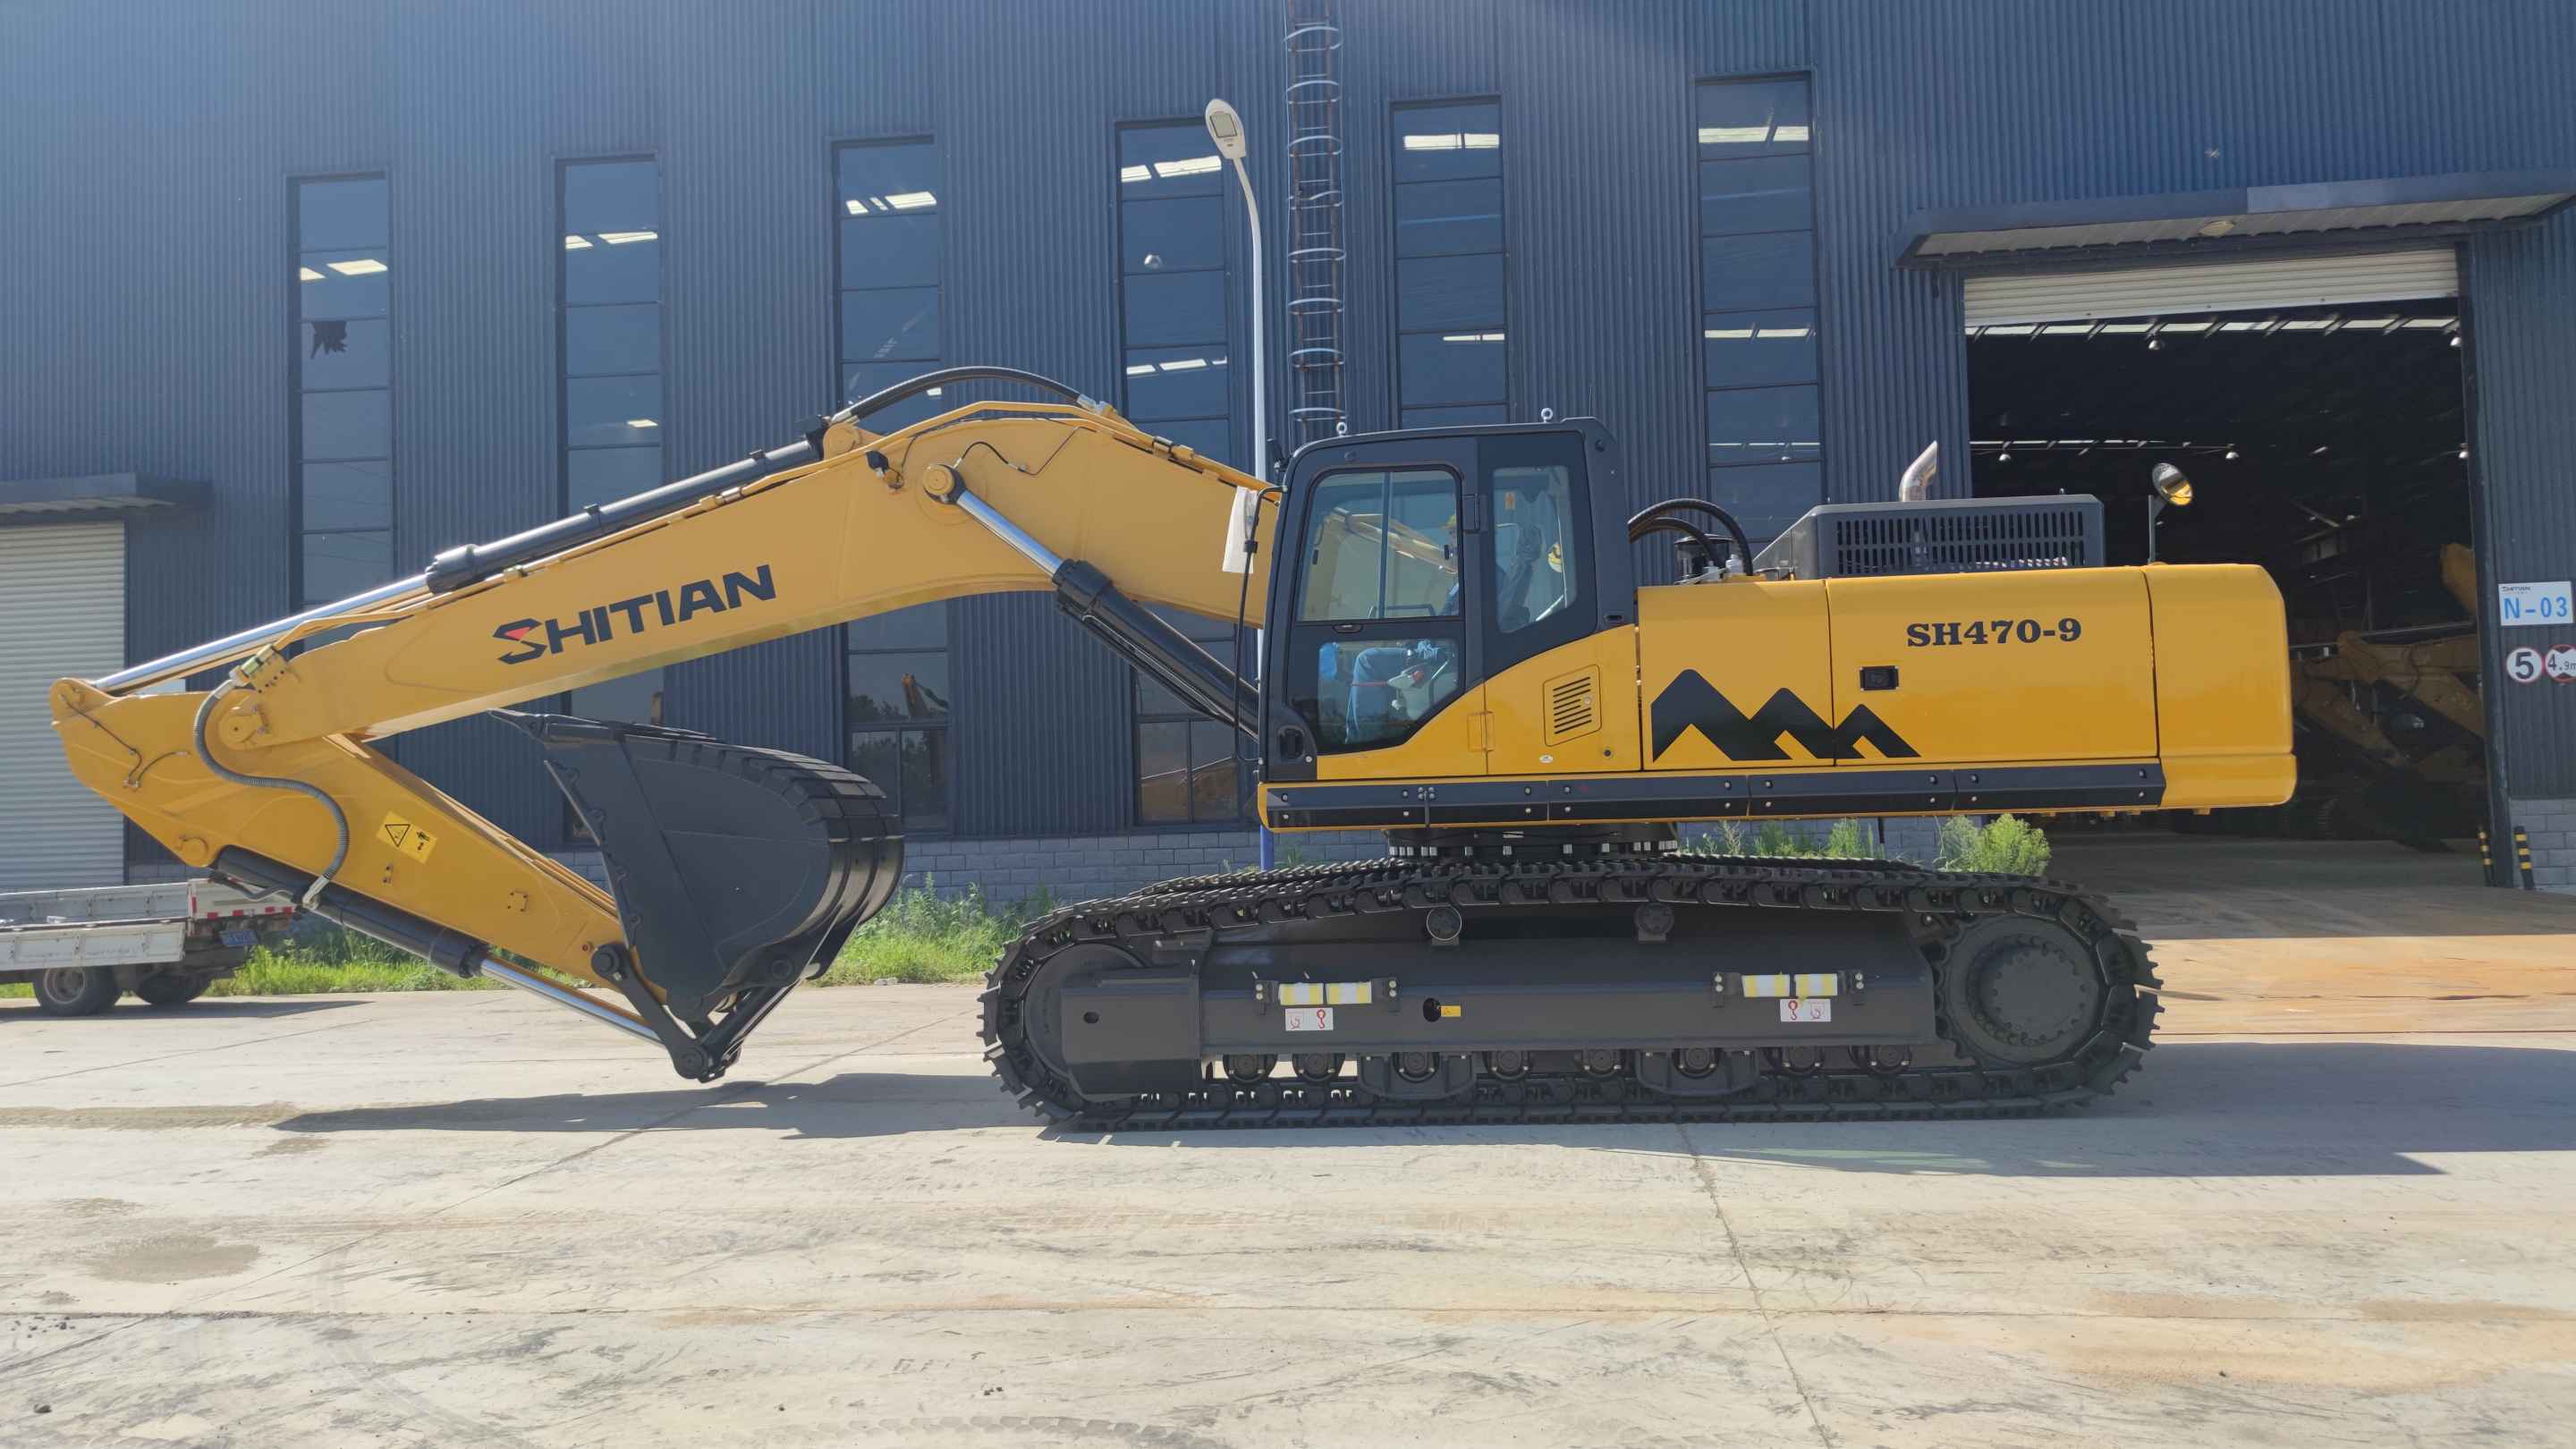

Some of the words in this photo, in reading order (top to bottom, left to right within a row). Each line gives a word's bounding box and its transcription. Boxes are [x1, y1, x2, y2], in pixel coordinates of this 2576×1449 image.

[493, 564, 776, 665] SHITIAN
[1906, 618, 2081, 647] SH470-9
[2515, 651, 2534, 680] 5
